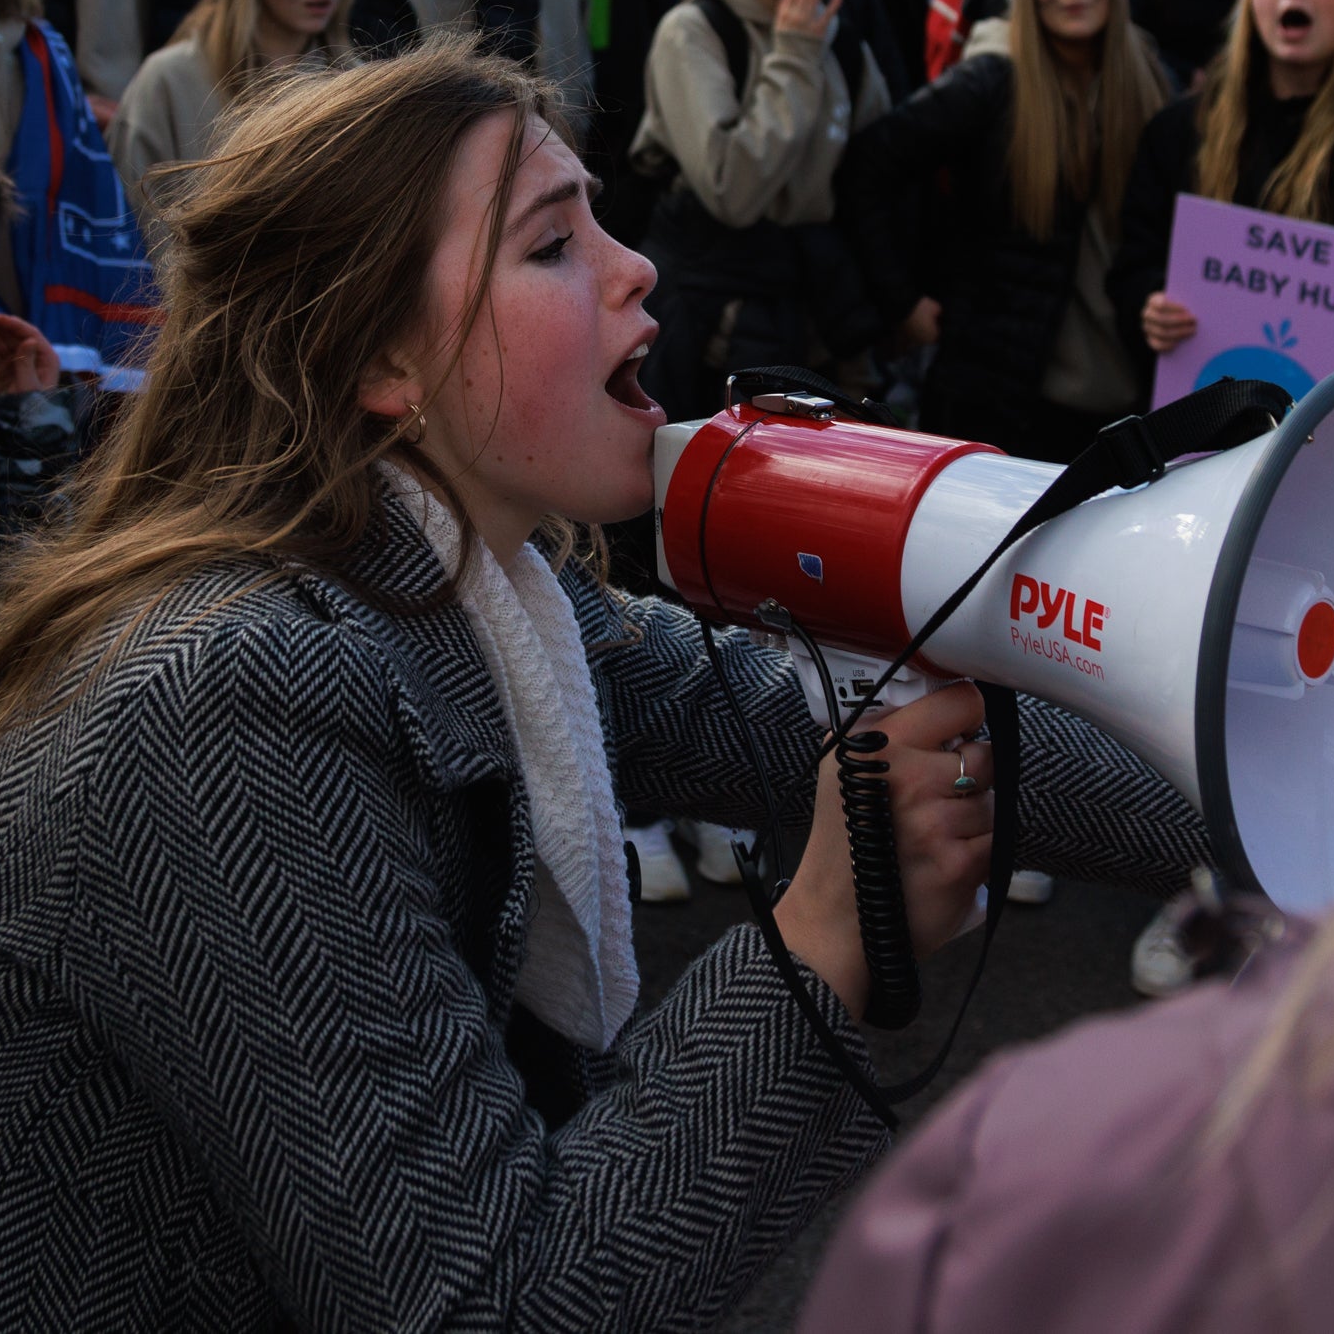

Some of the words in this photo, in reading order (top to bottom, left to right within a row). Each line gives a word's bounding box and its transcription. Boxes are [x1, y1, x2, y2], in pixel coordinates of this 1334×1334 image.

[1247, 225, 1332, 265] SAVE
[1201, 255, 1292, 298] BABY
[852, 669, 866, 678] USB
[1010, 626, 1105, 682] PyleUSA.com
